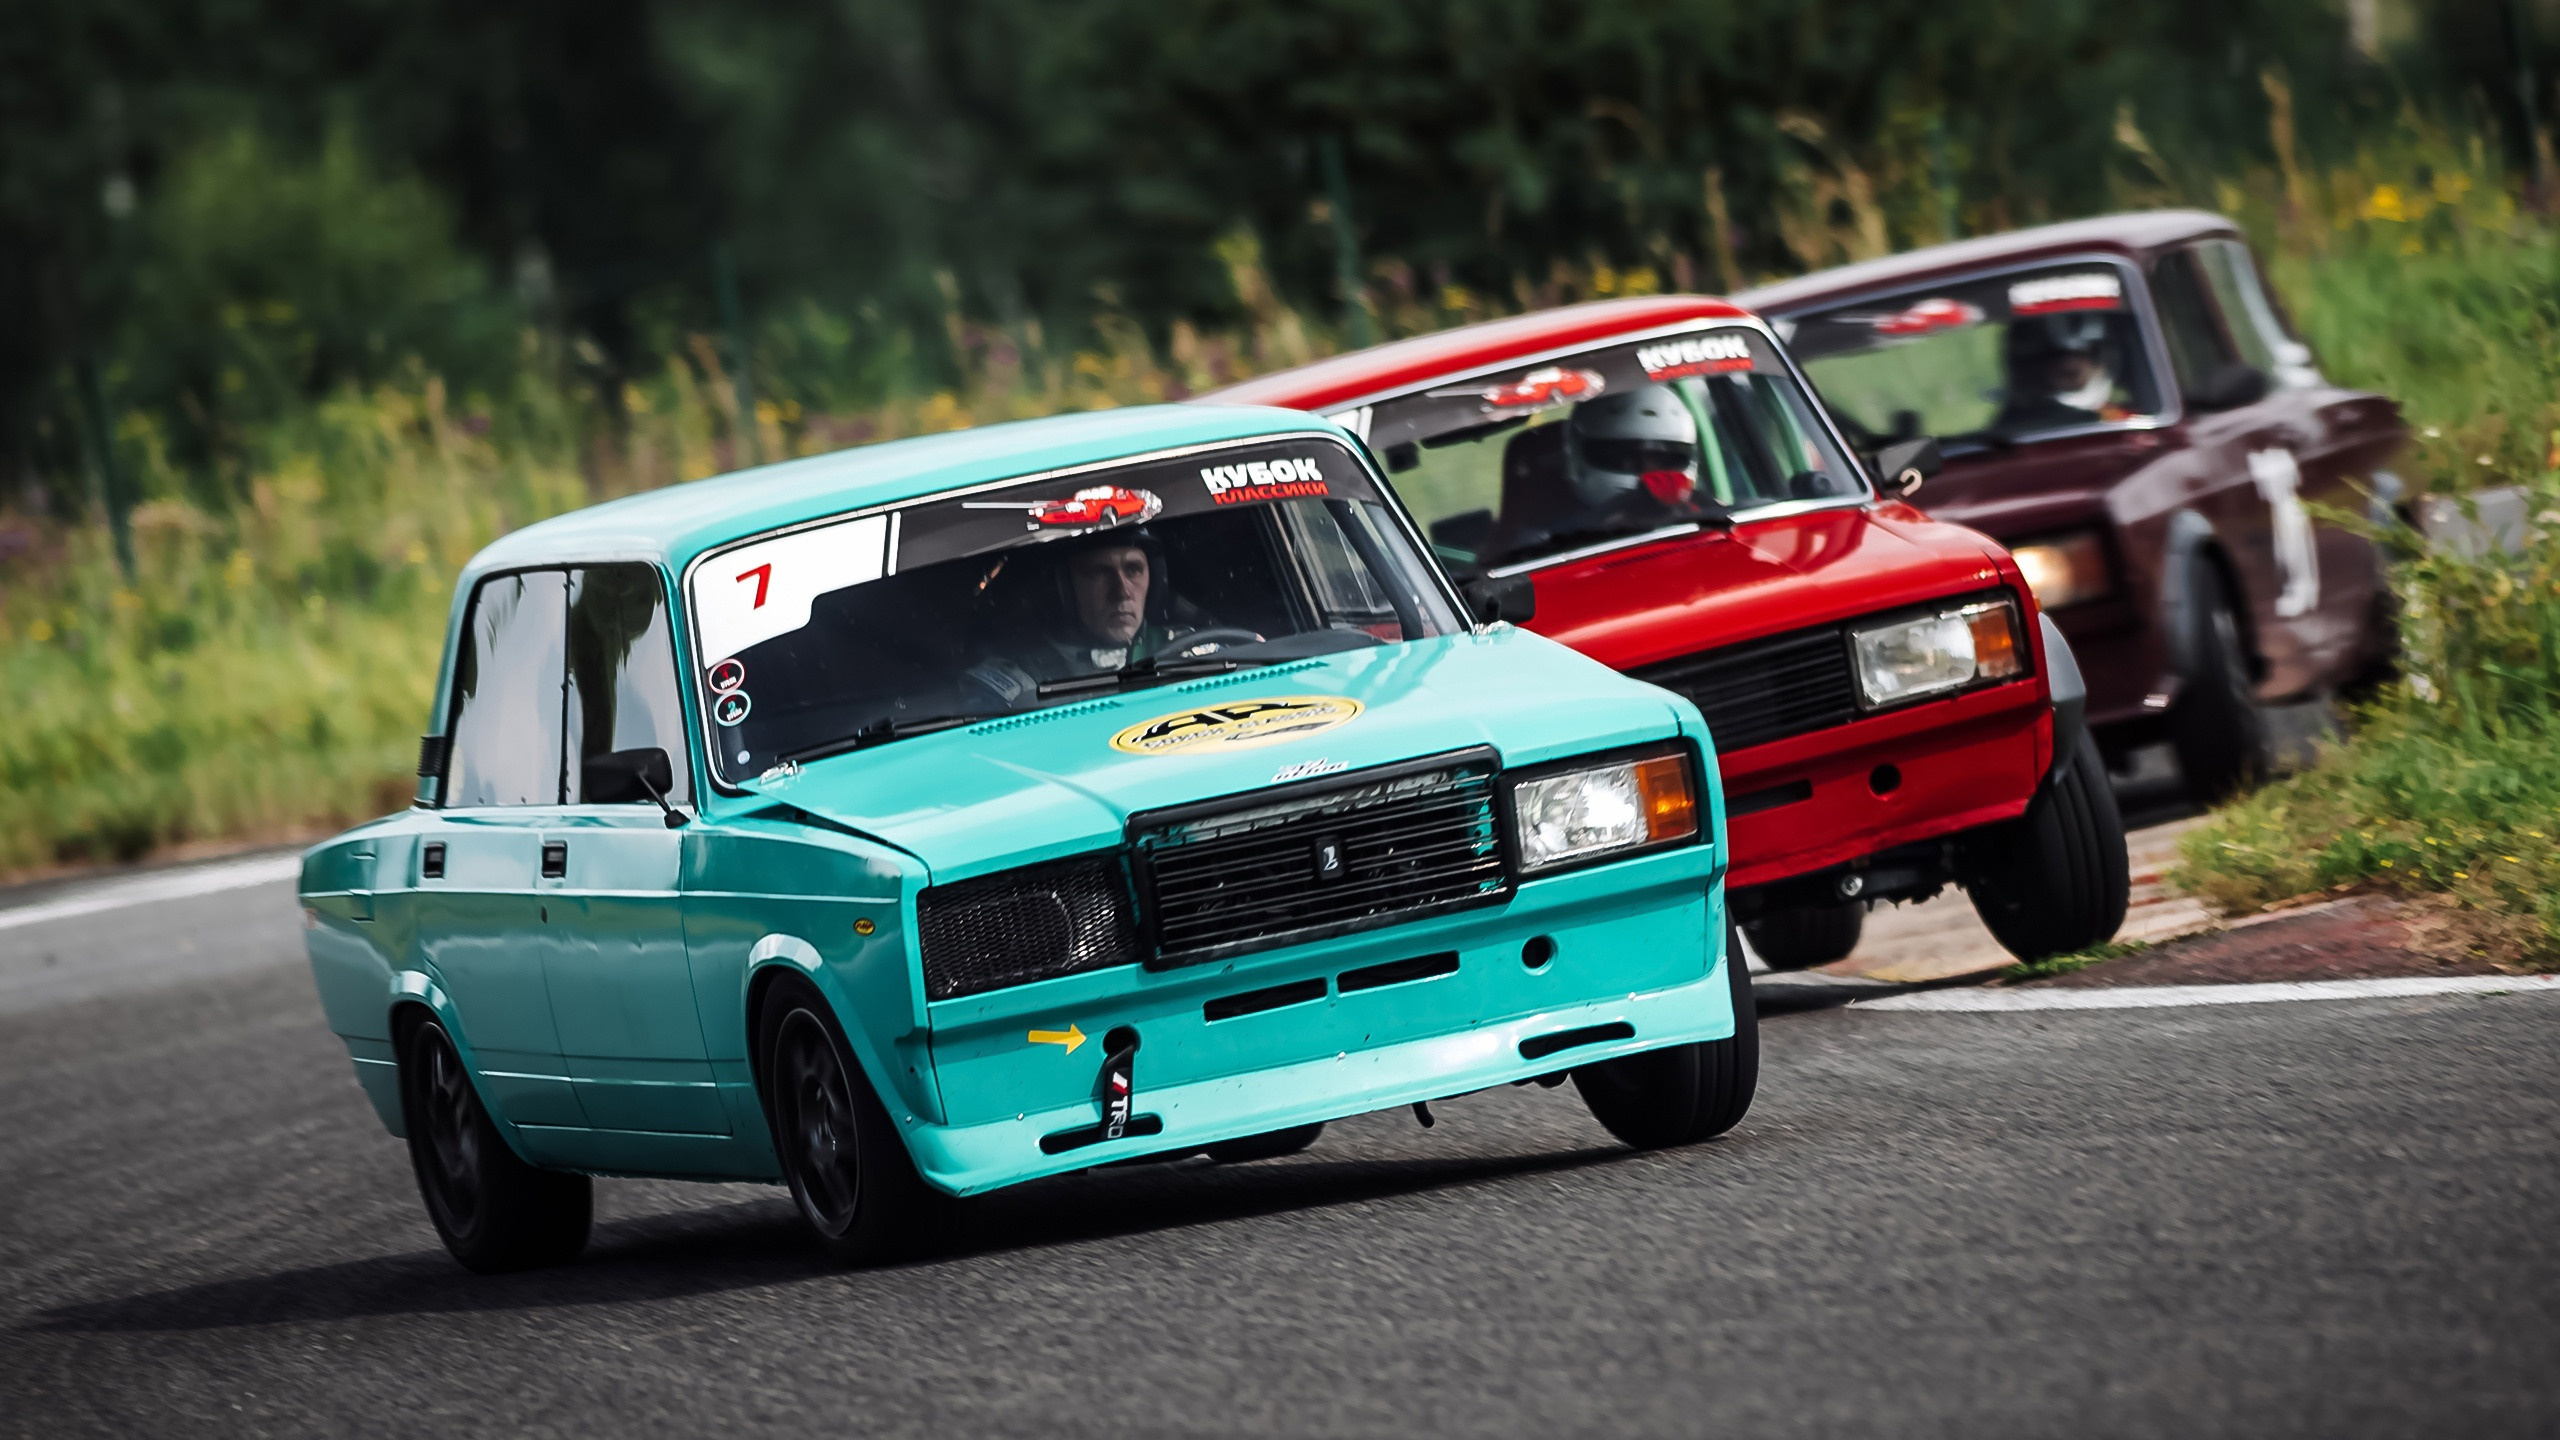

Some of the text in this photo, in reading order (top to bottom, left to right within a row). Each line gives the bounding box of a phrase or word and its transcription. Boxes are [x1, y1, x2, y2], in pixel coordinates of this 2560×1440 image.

[1200, 458, 1323, 495] КУБОК
[1213, 481, 1329, 504] КЛАССИКИ
[736, 563, 772, 610] 7
